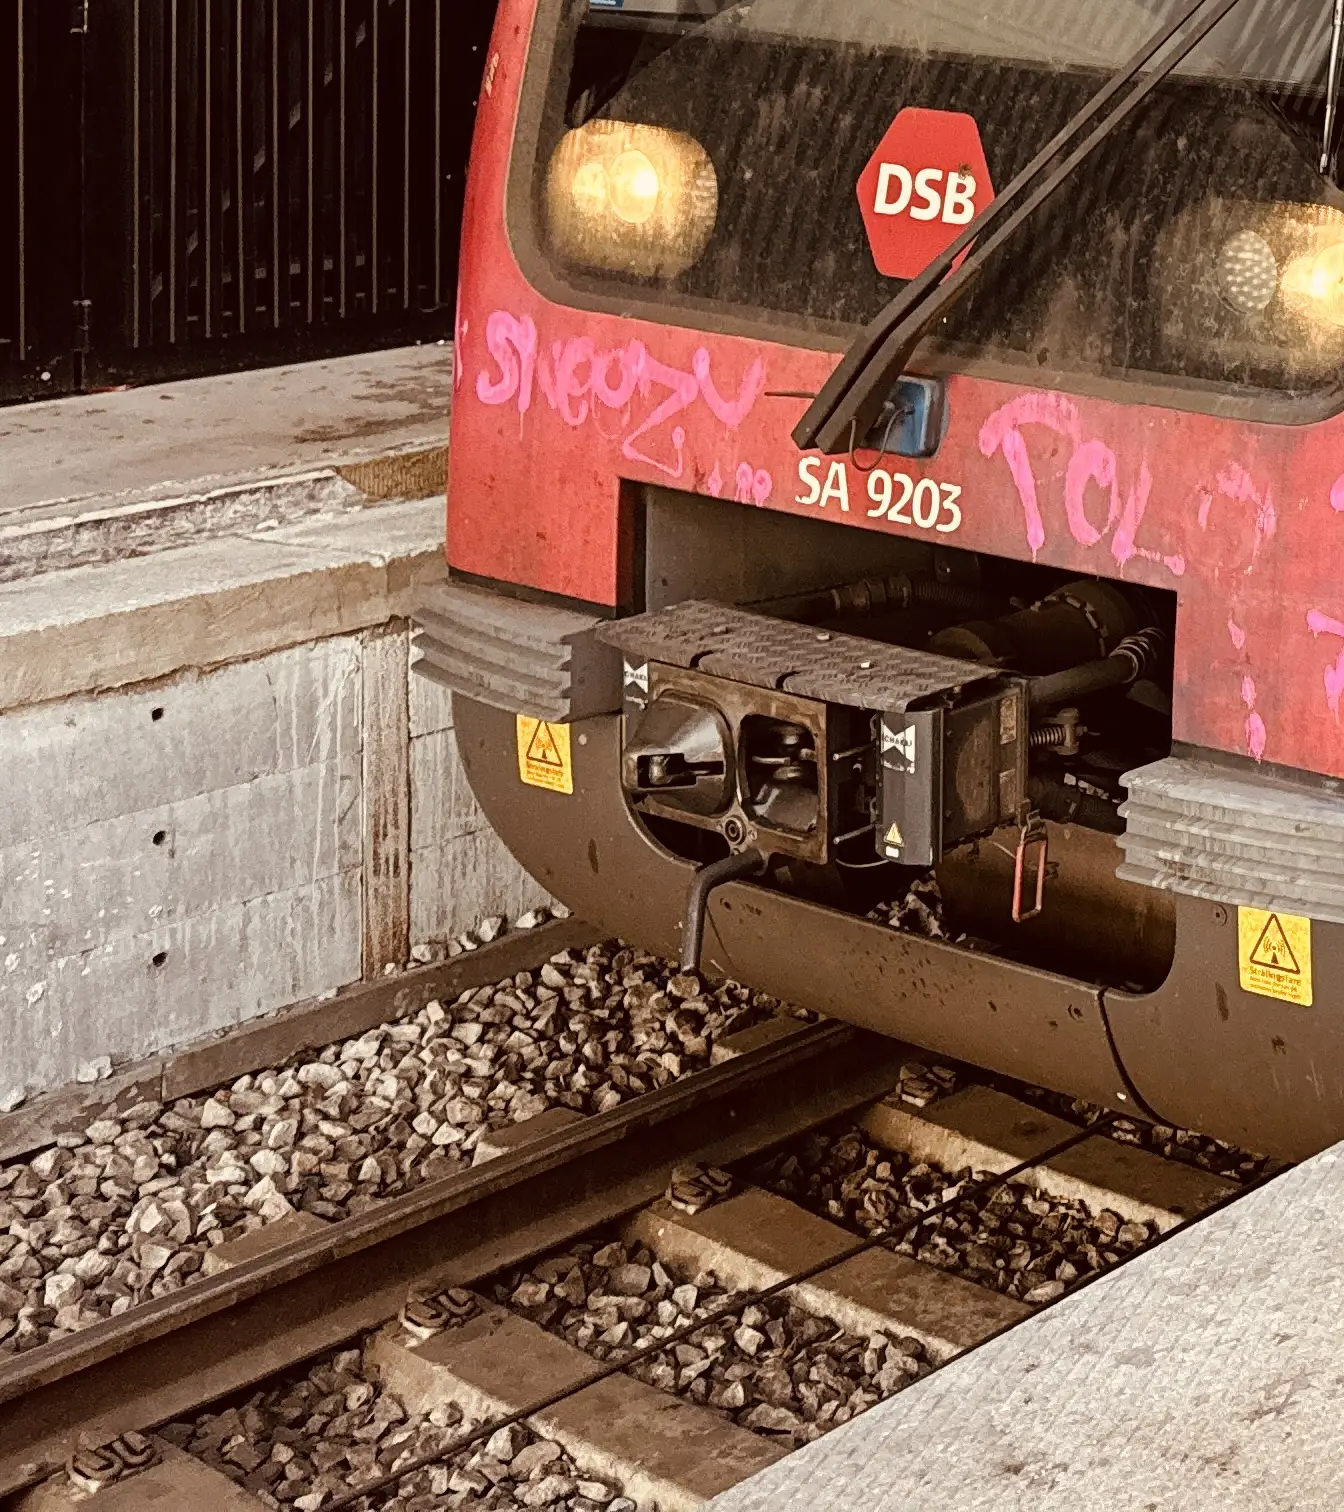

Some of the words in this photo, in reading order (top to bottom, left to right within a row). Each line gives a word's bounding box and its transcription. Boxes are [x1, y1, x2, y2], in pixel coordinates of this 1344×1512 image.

[872, 162, 977, 226] DSB
[794, 456, 850, 512] SA
[866, 470, 963, 533] 9203
